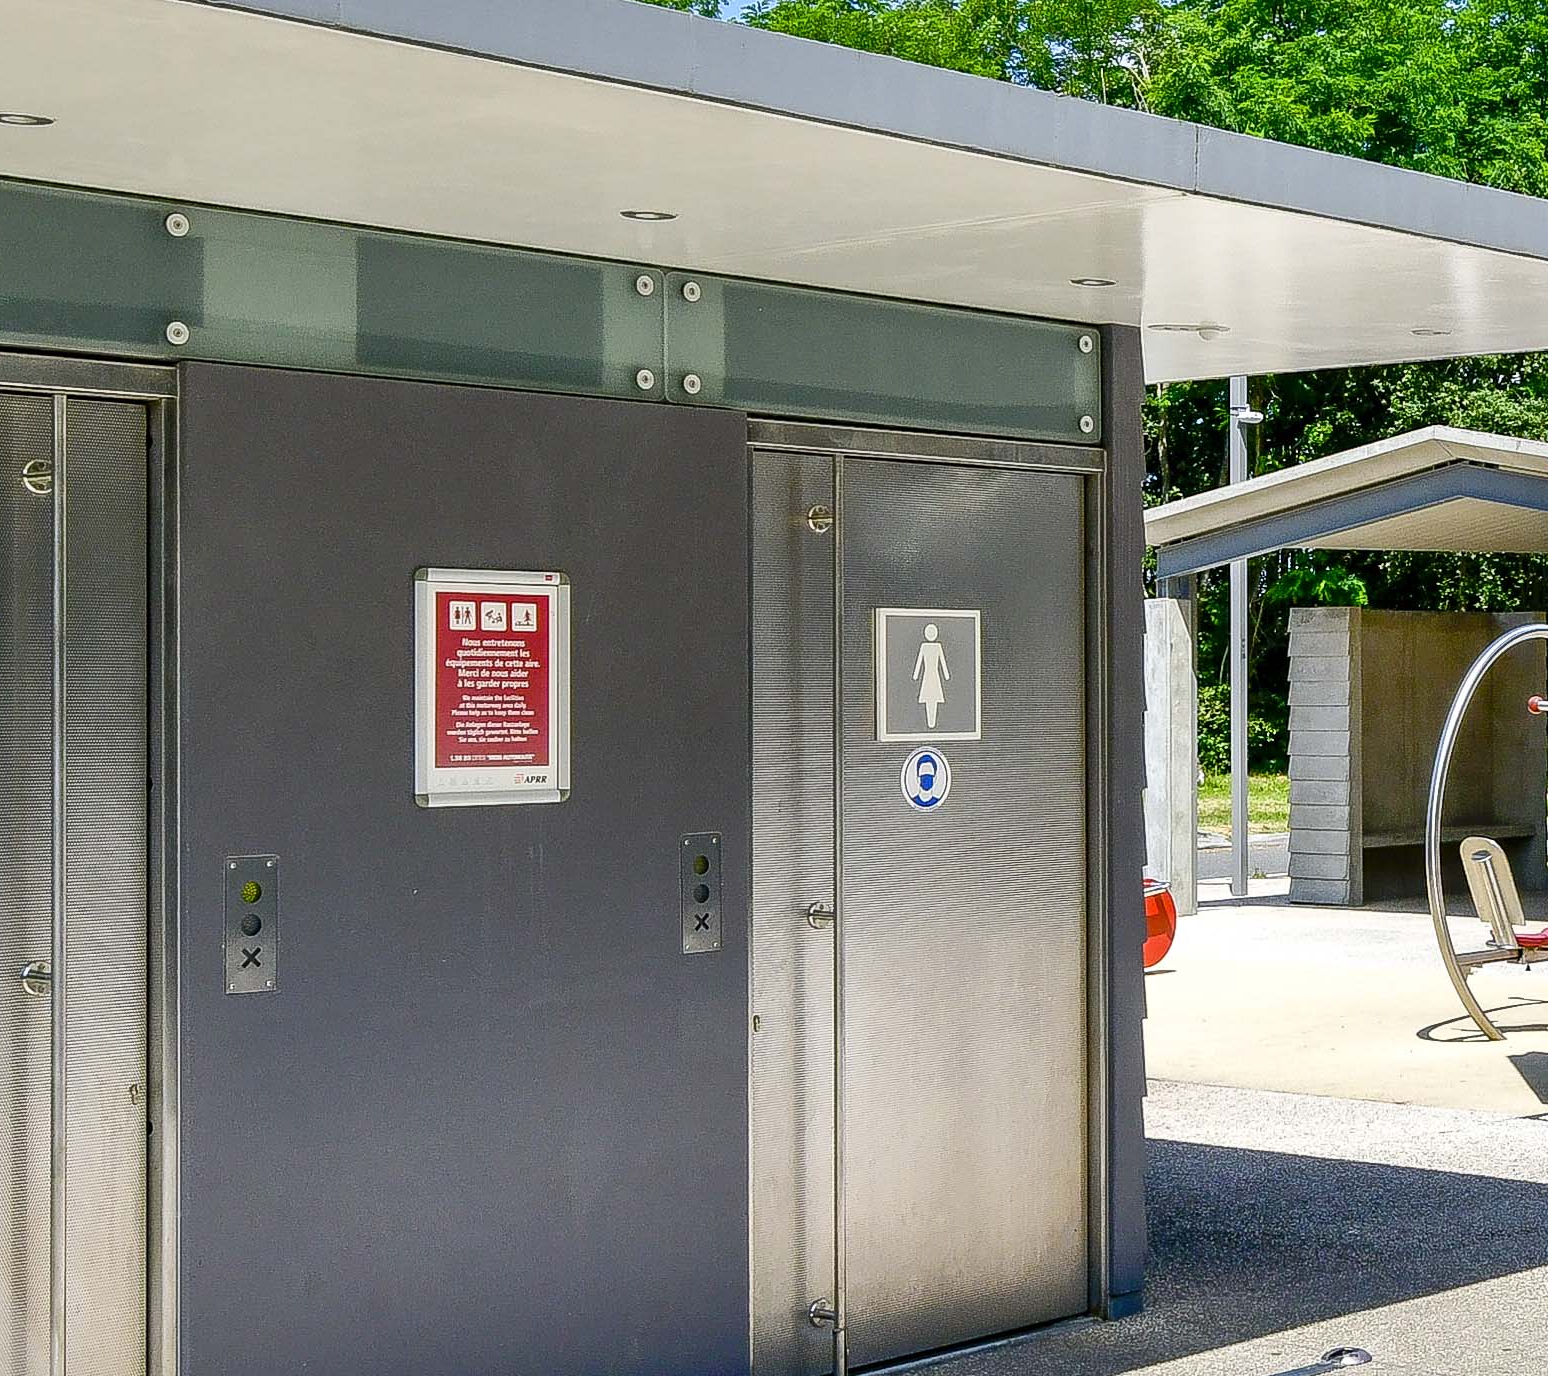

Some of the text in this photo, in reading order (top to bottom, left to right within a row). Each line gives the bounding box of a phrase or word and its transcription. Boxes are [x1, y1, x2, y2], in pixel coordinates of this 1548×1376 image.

[520, 649, 530, 658] les
[494, 659, 504, 667] de
[505, 660, 523, 668] cette
[458, 669, 479, 677] Merci
[481, 669, 490, 677] de
[510, 669, 529, 677] aider
[464, 679, 475, 687] les
[476, 679, 500, 689] garder
[501, 681, 529, 689] propres
[524, 775, 547, 784] APRR
